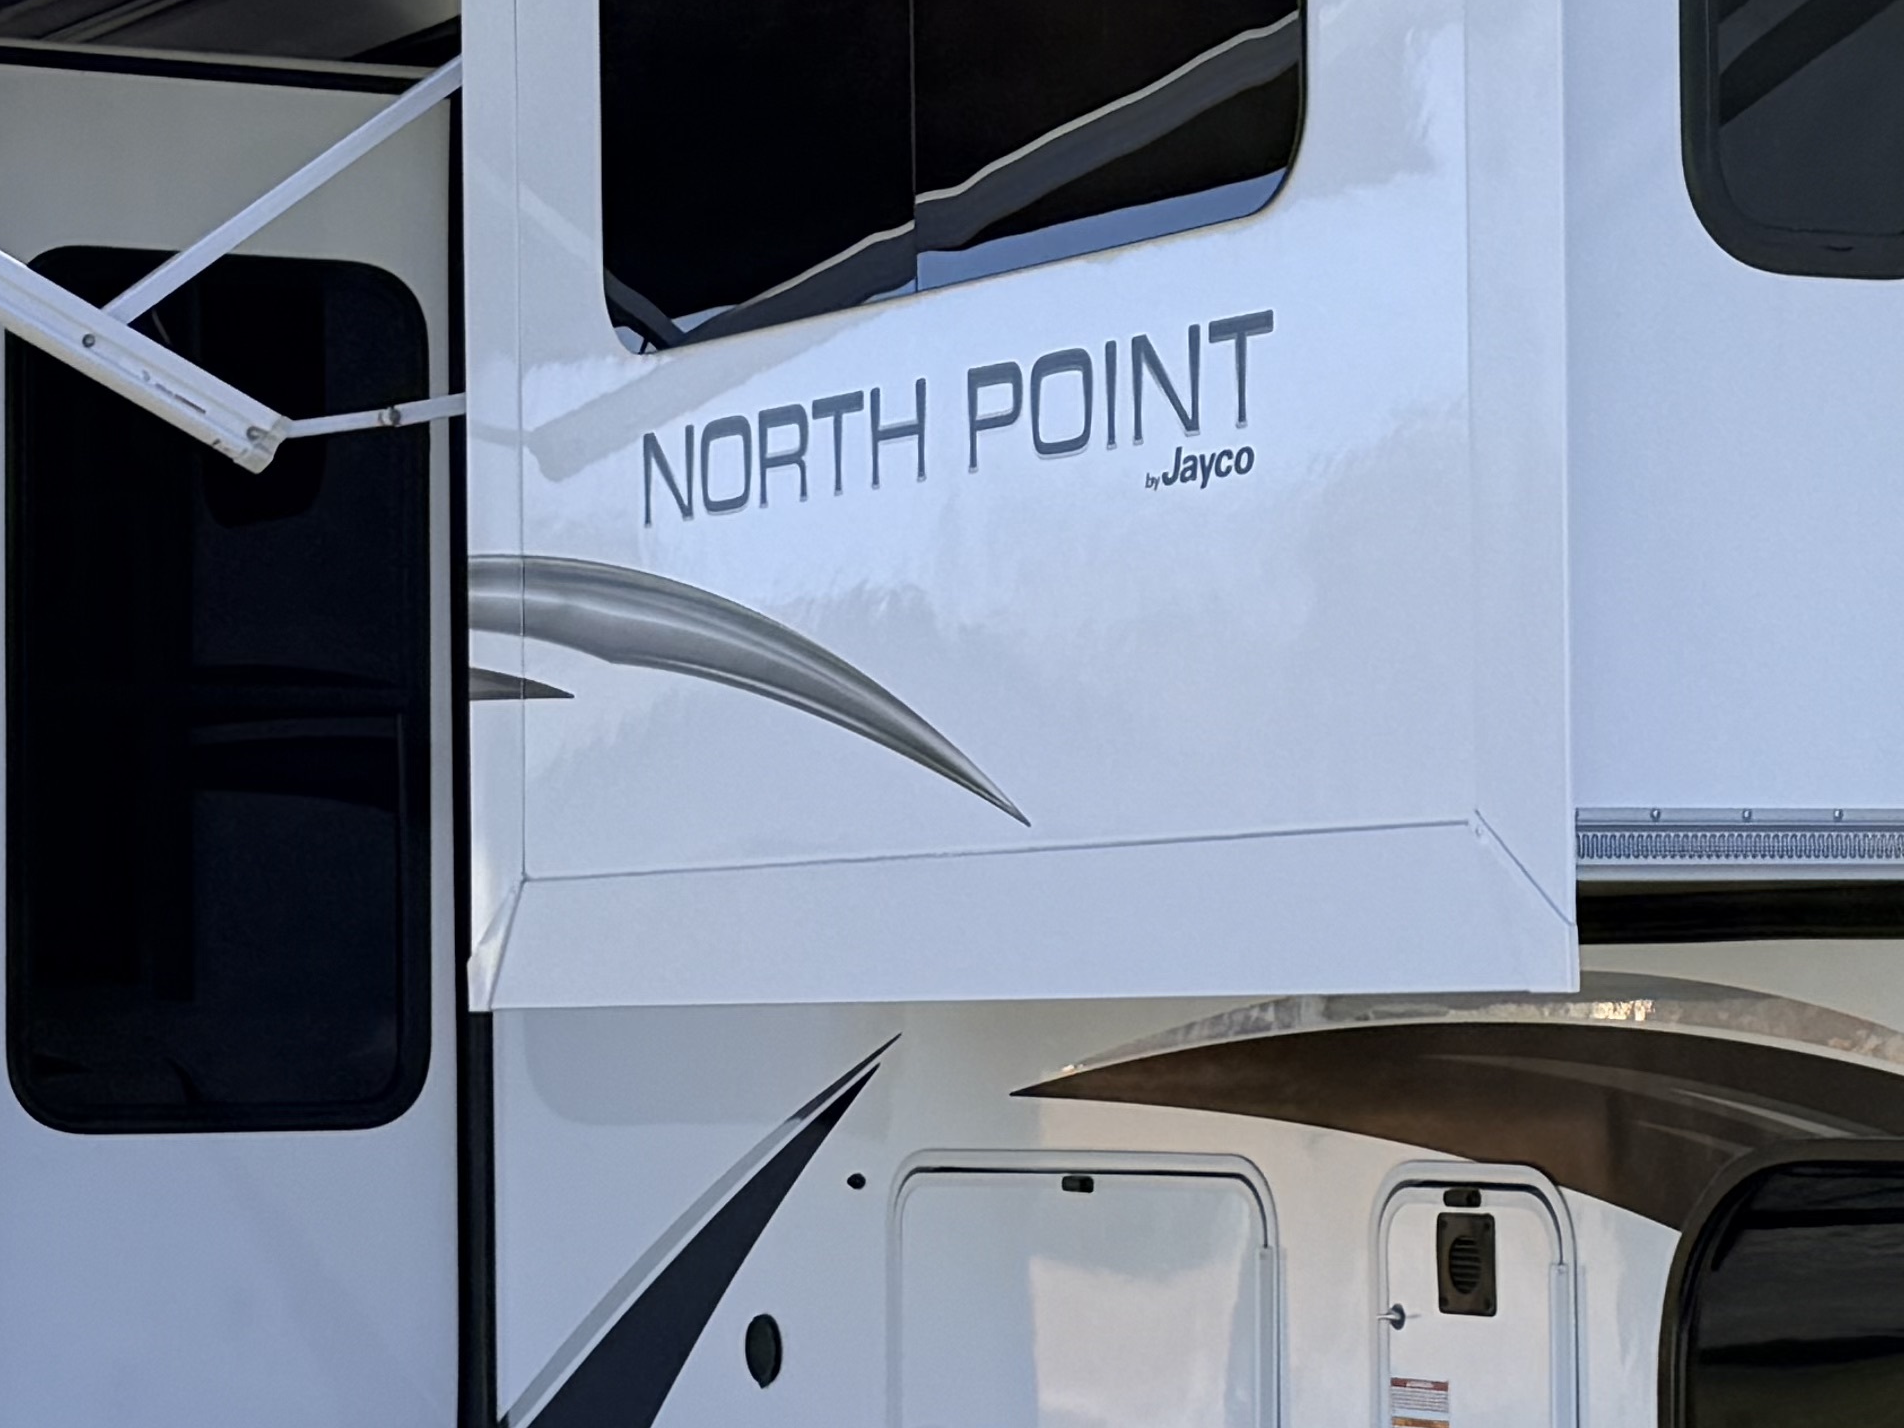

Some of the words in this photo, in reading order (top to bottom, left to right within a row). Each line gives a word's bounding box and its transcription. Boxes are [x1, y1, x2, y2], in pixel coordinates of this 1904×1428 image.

[643, 377, 927, 528] NORTH
[967, 309, 1274, 474] POINT
[1145, 472, 1160, 491] by
[1162, 446, 1254, 489] Jayco
